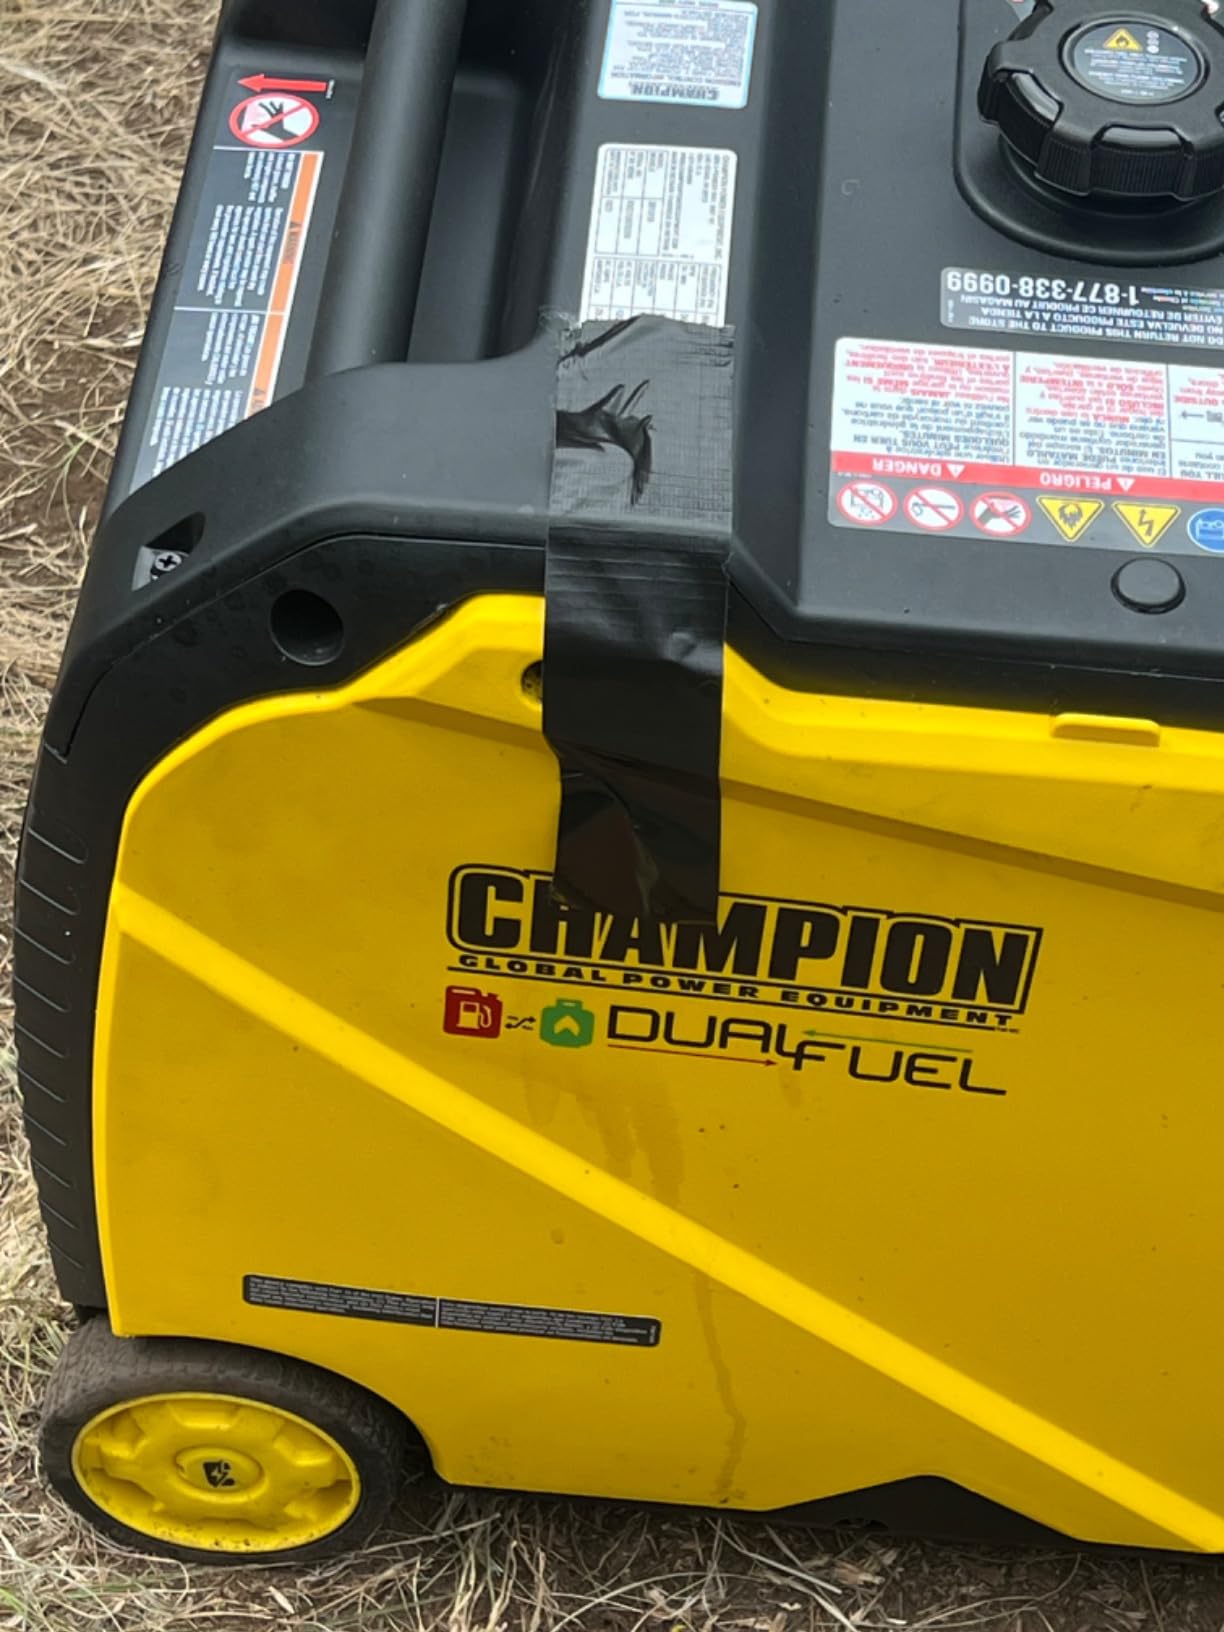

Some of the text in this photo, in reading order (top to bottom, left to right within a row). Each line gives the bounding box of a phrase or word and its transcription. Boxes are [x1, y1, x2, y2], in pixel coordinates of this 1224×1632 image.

[946, 269, 1139, 306] 1-877-338-0999
[960, 292, 1012, 307] MAGASIN
[1013, 297, 1030, 308] AU
[1031, 299, 1079, 313] PRODUIT
[1081, 303, 1095, 314] CE
[980, 305, 1222, 336] NO DEVUELVA ESTE PRODUCTO A LA TIENDA
[1098, 305, 1163, 320] RETOURNER
[1166, 311, 1181, 322] DE
[967, 314, 1222, 346] DO NOT RETURN THIS PRODUCT TO THE STORE
[871, 457, 941, 476] DANGER
[1039, 471, 1112, 490] PELIGRO
[457, 872, 1030, 1006] CHAMPION
[458, 954, 1013, 1027] GLOBAL POWER EQUIPMENT
